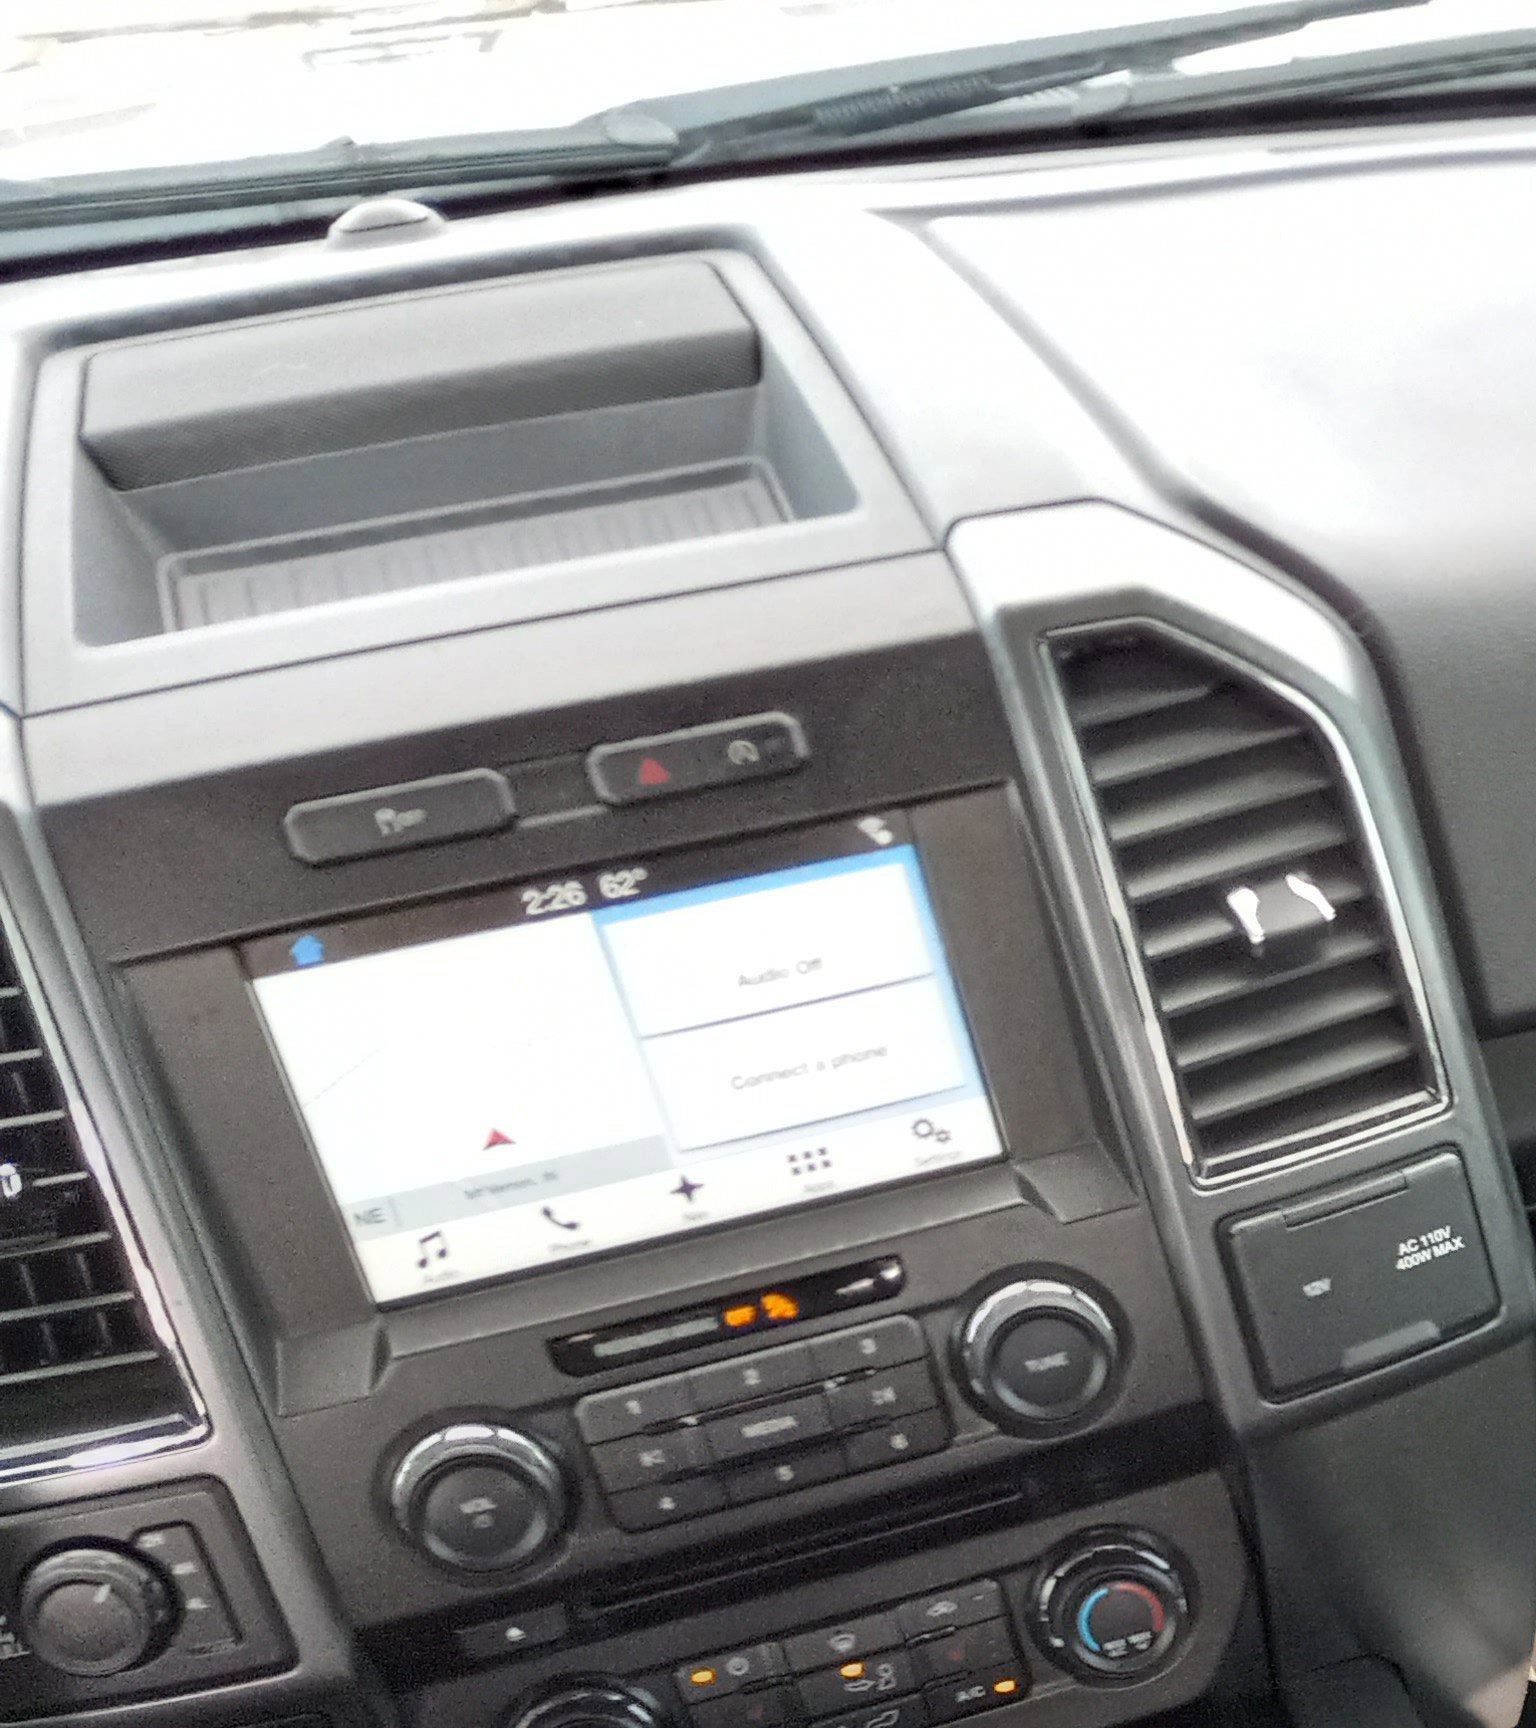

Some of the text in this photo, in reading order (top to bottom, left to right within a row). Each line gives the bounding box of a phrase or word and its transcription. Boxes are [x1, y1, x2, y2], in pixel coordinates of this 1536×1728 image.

[731, 1063, 808, 1090] Connect
[831, 1046, 888, 1069] phone
[1396, 1236, 1466, 1271] 400W MAX
[1398, 1225, 1452, 1256] AC 110V
